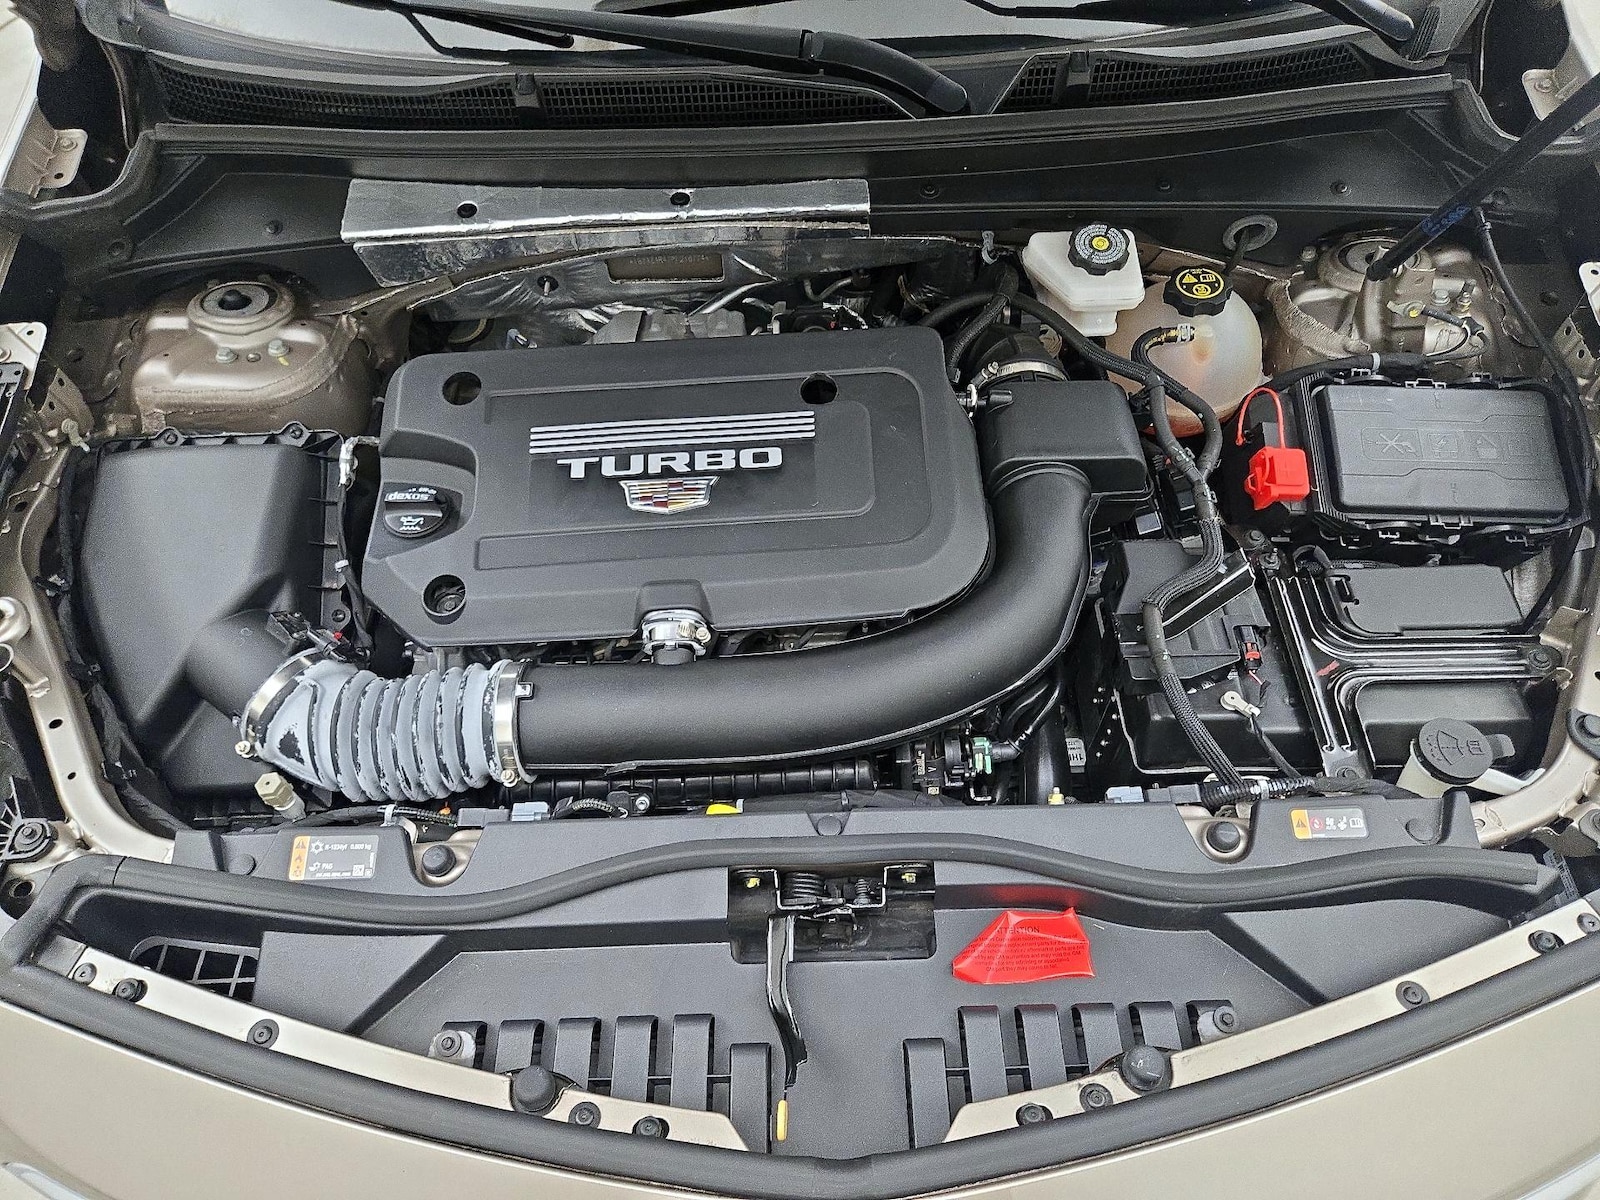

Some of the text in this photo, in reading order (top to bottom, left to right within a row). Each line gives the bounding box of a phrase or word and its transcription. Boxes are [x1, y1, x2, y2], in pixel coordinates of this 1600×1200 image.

[556, 446, 783, 479] TURBO
[388, 491, 431, 501] dexos
[321, 862, 334, 870] PAG
[995, 926, 1040, 936] ATTENTION
